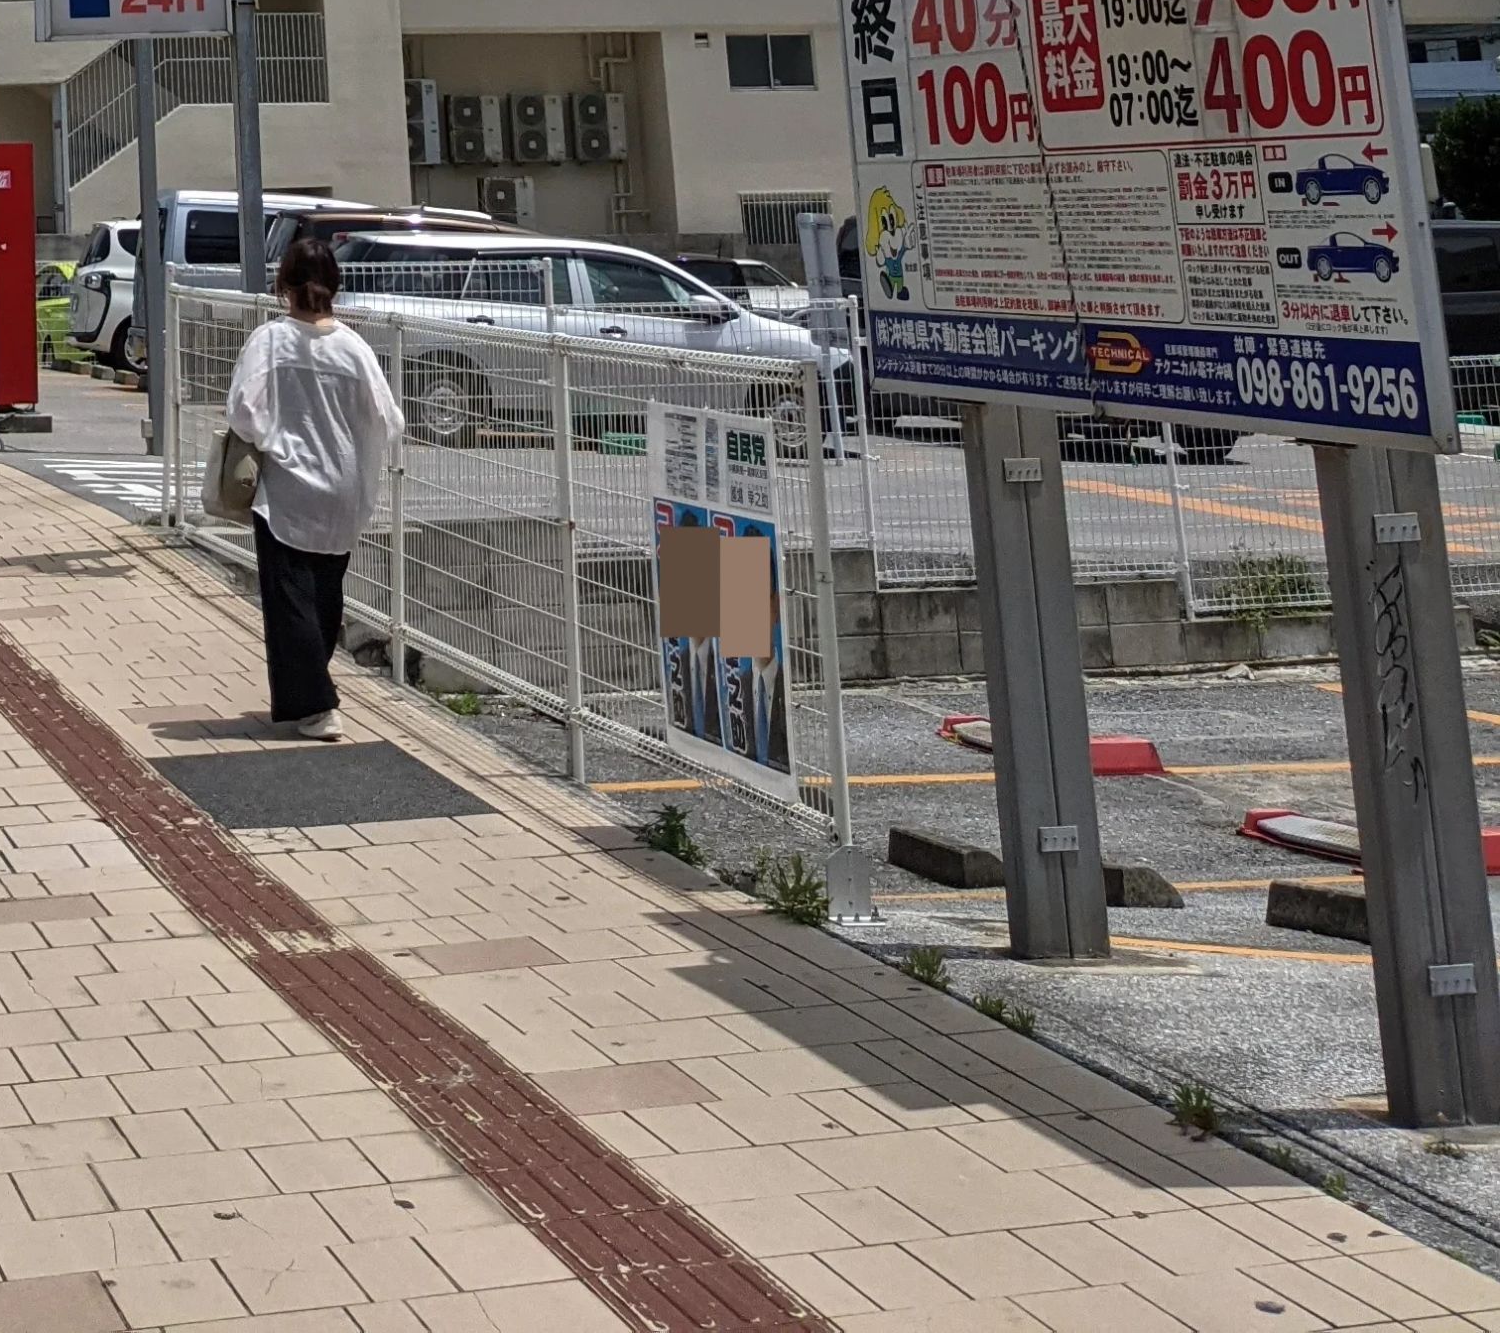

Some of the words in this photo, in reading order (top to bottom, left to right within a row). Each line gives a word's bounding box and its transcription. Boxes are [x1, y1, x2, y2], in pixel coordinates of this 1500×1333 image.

[1044, 47, 1098, 100] 料金
[1203, 29, 1376, 134] 400円
[917, 61, 1035, 146] 100円
[1177, 169, 1257, 201] 罰金3万円
[1274, 177, 1286, 188] IN
[1195, 203, 1245, 220] 申し受けます
[1279, 254, 1299, 265] OUT
[1090, 345, 1150, 362] TECHNICAL
[1233, 335, 1327, 360] 故障・緊急連絡先
[1154, 358, 1234, 382] テクニカル電子沖縄
[1236, 356, 1419, 420] 098-861-9256
[725, 429, 767, 467] 自民党
